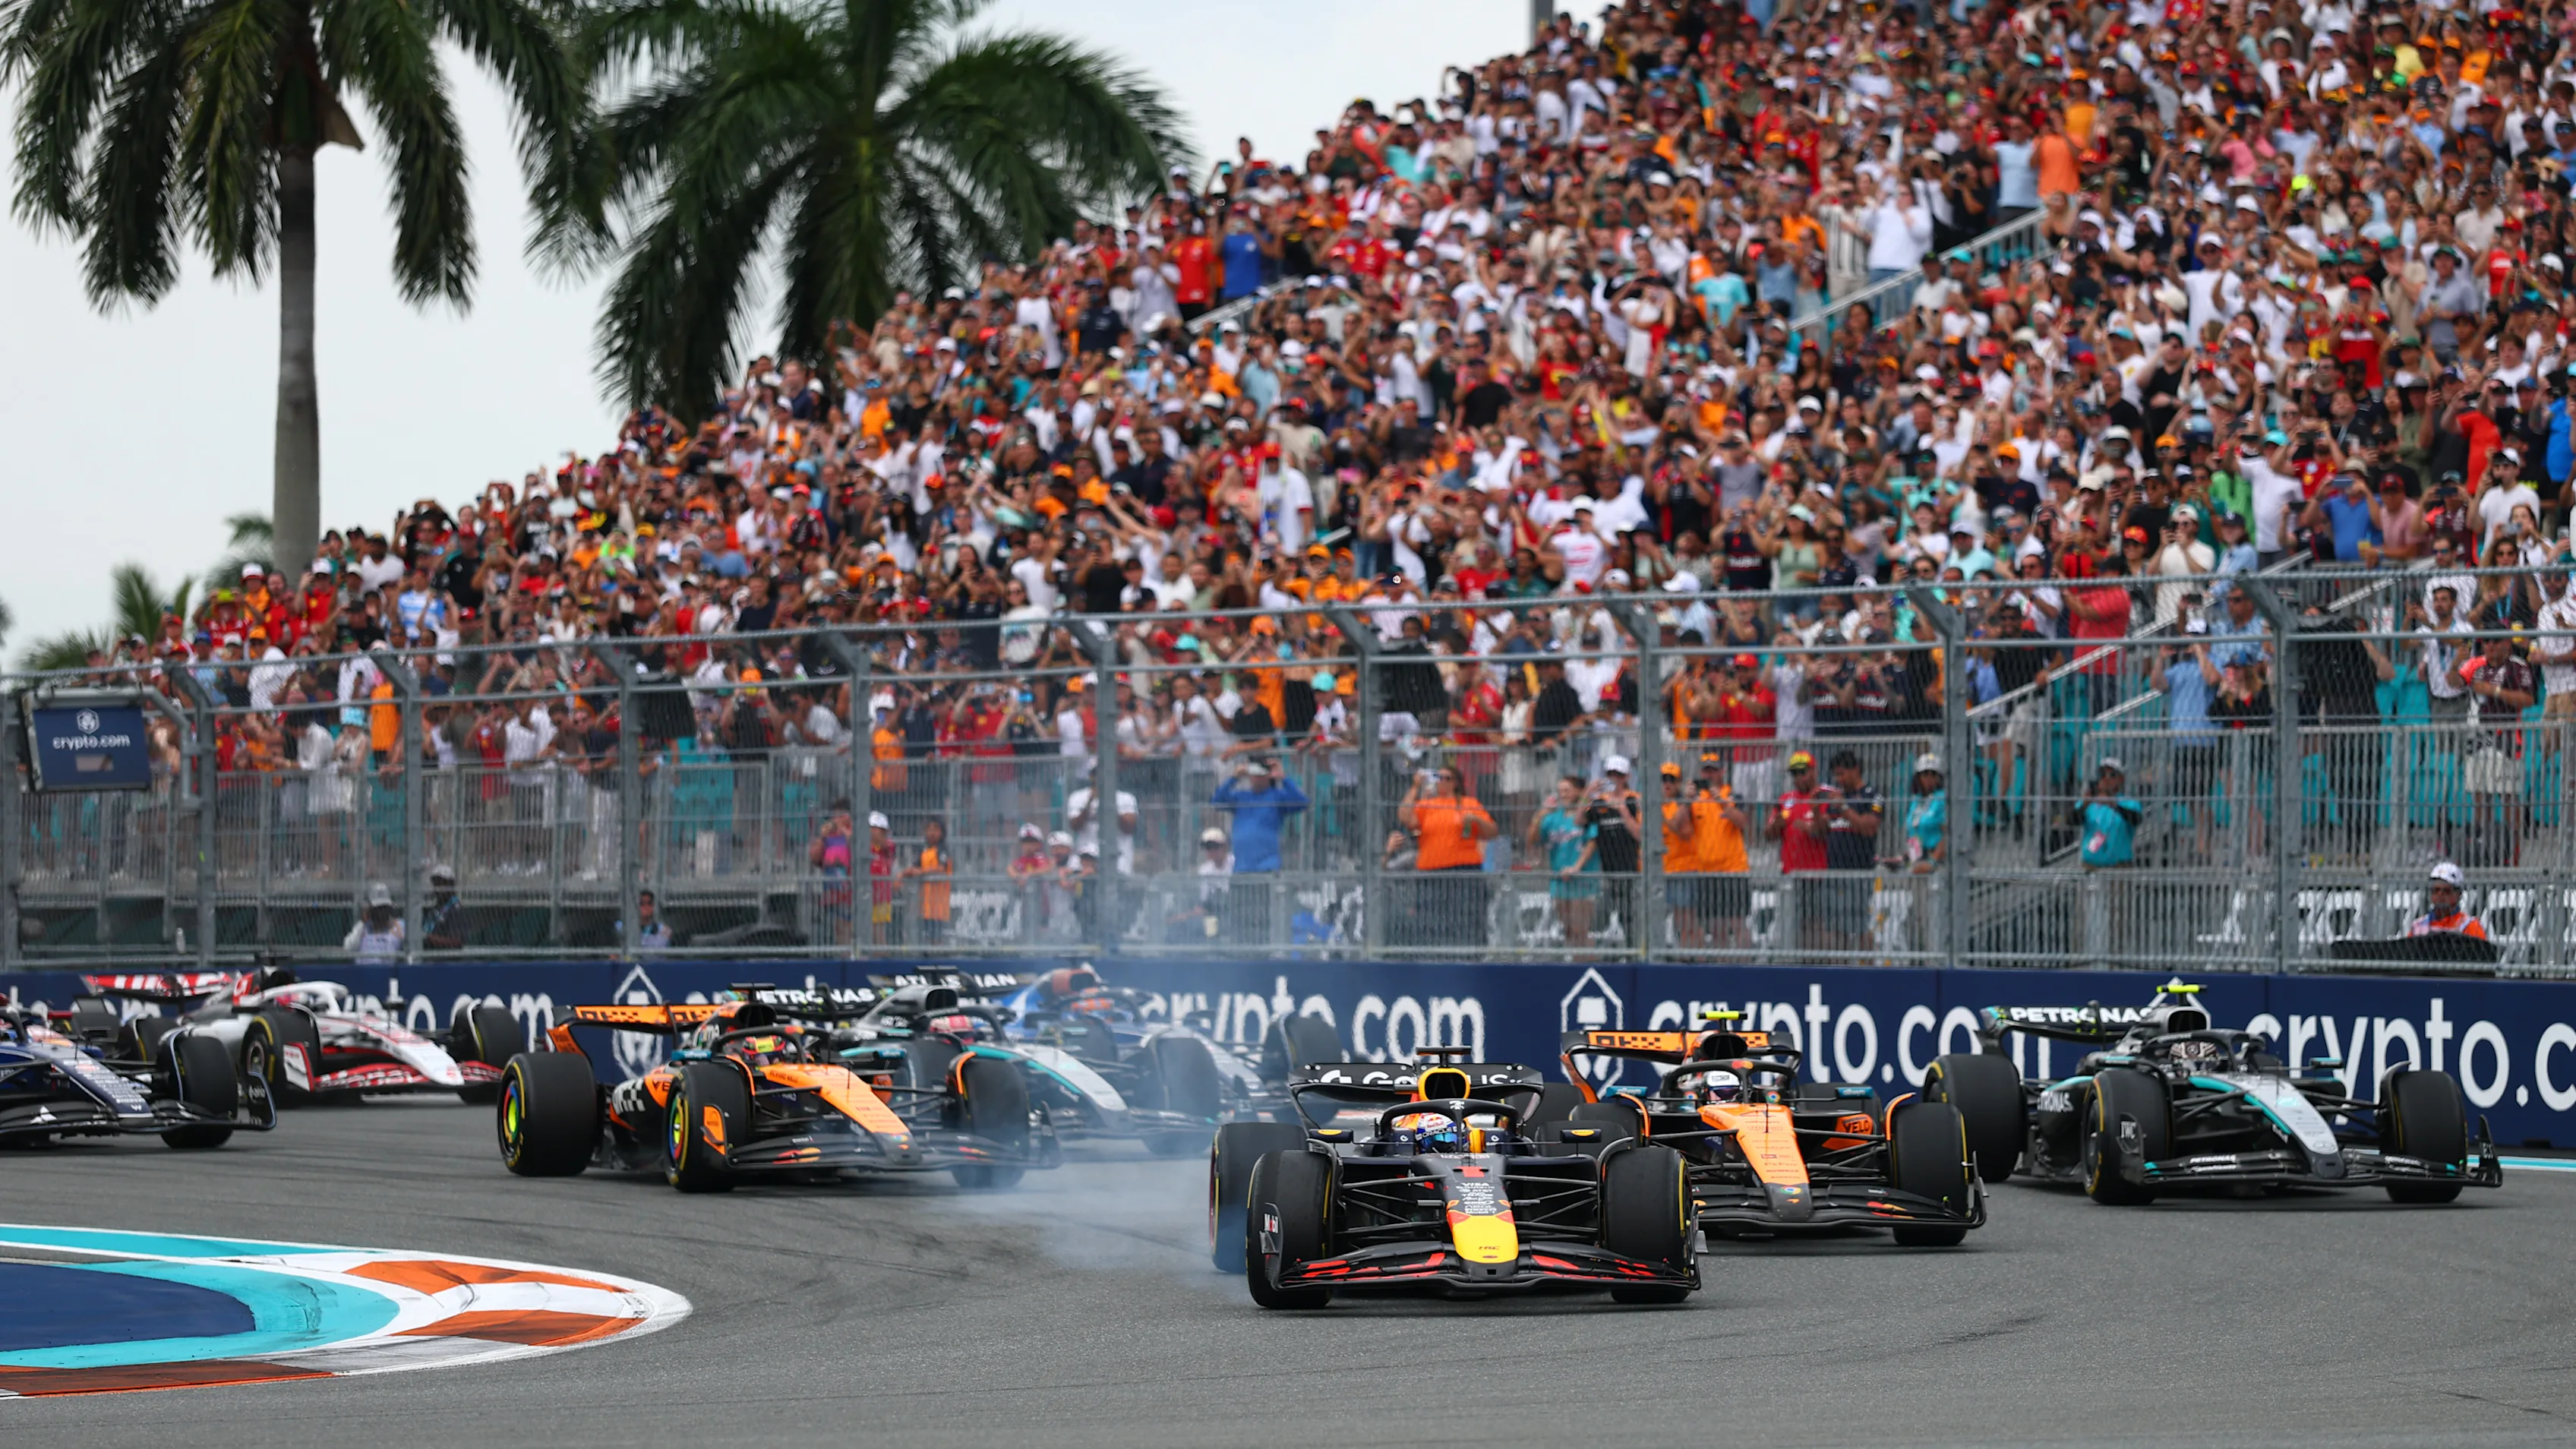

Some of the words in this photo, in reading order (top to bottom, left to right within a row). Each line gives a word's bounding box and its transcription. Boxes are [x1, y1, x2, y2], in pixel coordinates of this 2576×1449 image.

[52, 733, 131, 750] crypto.com
[895, 974, 1017, 988] ATLSIAN
[2009, 1006, 2153, 1024] PETRONAS
[1648, 984, 2051, 1088] crpto.co
[652, 1081, 671, 1092] VE
[2037, 1091, 2075, 1113] ETRONAS
[2120, 1121, 2136, 1138] IWC
